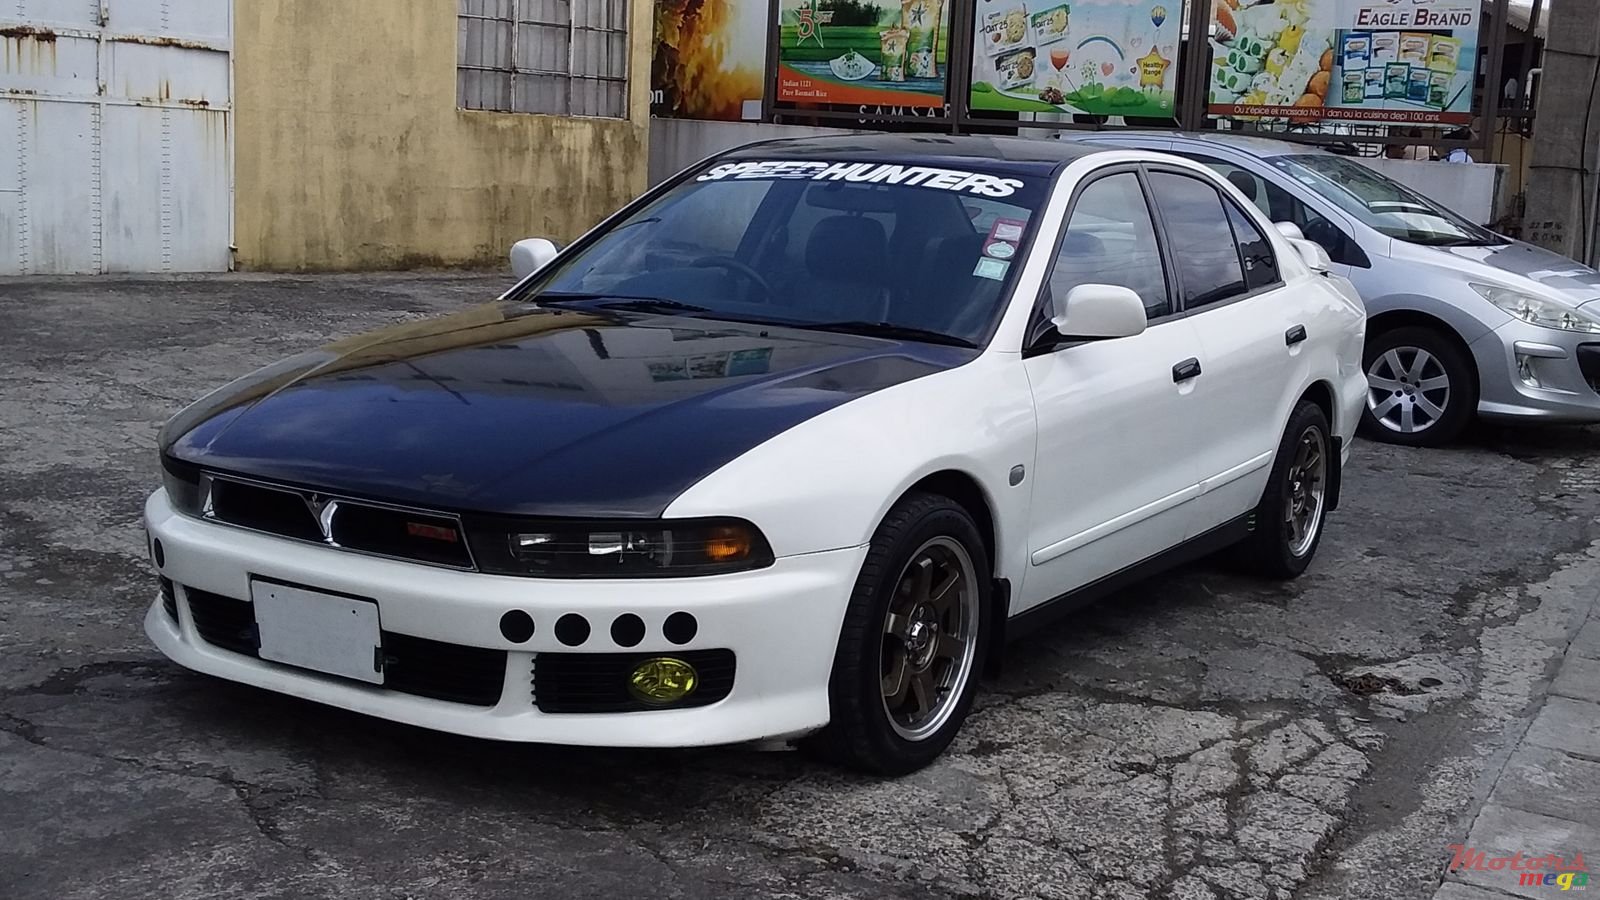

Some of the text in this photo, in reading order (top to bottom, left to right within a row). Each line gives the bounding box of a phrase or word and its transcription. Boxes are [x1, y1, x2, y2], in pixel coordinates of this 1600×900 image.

[1357, 8, 1472, 26] EAGLE BRAND
[1143, 62, 1164, 70] Healthy
[1143, 69, 1161, 77] Range
[1410, 112, 1424, 121] 100
[696, 161, 1024, 197] SPEEDHUNTERS
